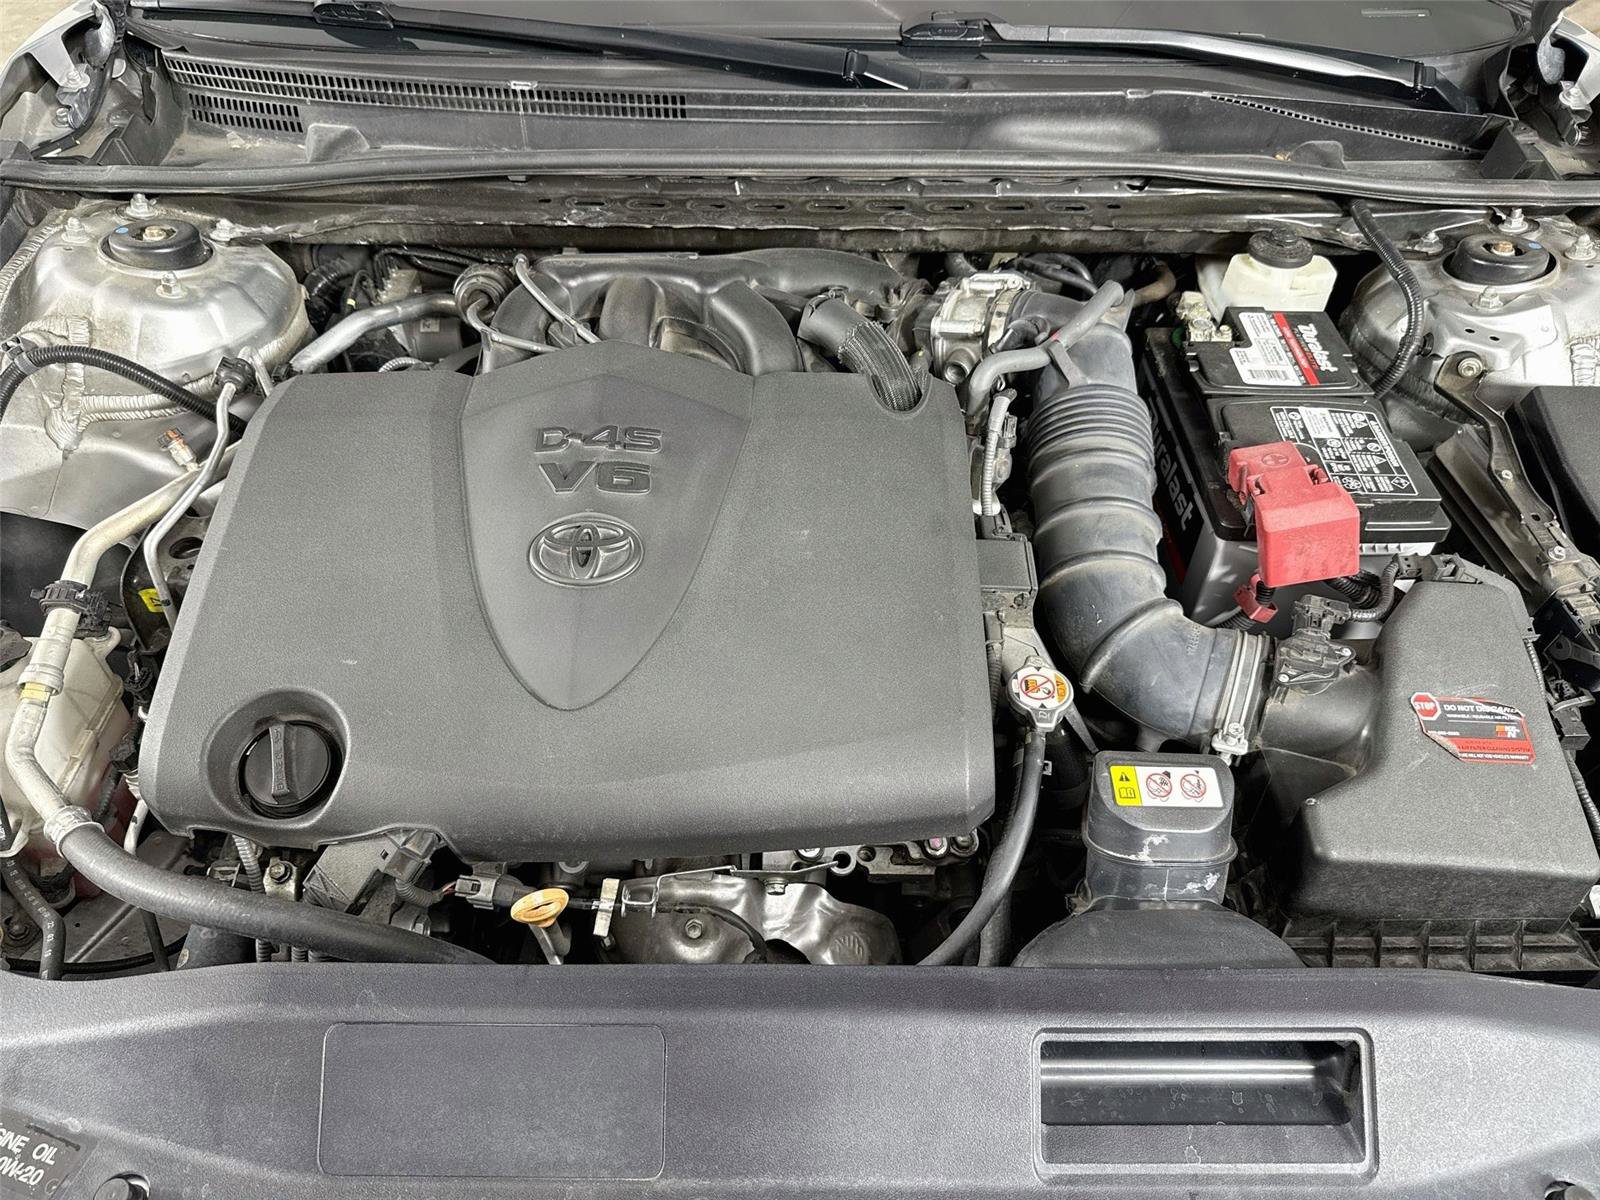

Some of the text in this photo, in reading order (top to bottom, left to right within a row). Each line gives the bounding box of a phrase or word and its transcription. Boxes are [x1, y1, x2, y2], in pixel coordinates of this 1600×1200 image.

[1296, 323, 1338, 372] Duralast
[534, 426, 662, 454] D-4S
[539, 460, 651, 495] V6
[1414, 701, 1436, 711] STOP
[1443, 704, 1456, 712] DO
[1457, 704, 1475, 712] NOT
[32, 1143, 58, 1166] OIL
